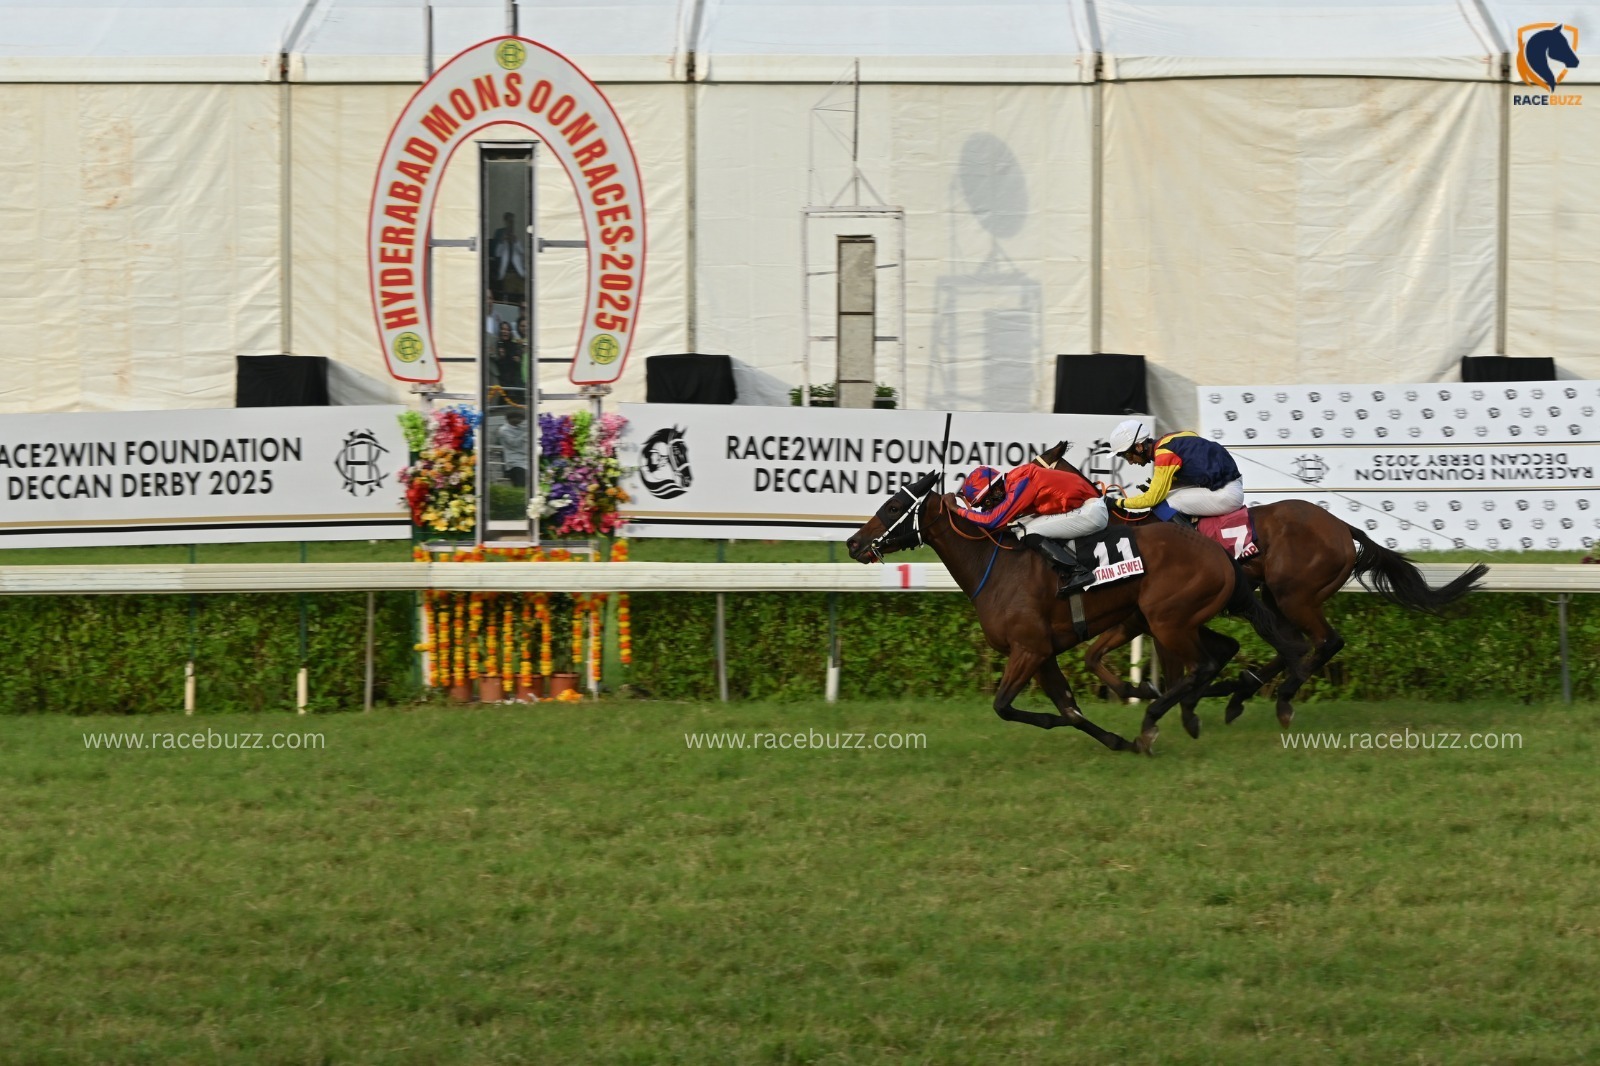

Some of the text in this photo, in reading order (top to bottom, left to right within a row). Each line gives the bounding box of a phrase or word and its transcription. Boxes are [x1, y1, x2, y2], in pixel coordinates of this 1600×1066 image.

[379, 136, 440, 330] HYDERABAD
[419, 72, 599, 147] MONSOON
[125, 437, 302, 466] FOUNDATION
[726, 435, 1047, 467] RACE2WIN FOUNDATION
[1372, 453, 1568, 467] DECCAN DERBY 2025
[8, 470, 273, 500] DECCAN DERBY 2025
[754, 467, 858, 494] DECCAN
[1355, 466, 1594, 481] RACE2WIN FOUNDATION
[1093, 537, 1134, 567] 11
[1220, 524, 1249, 560] 7
[897, 564, 911, 589] 1
[1116, 560, 1144, 576] JEWEL
